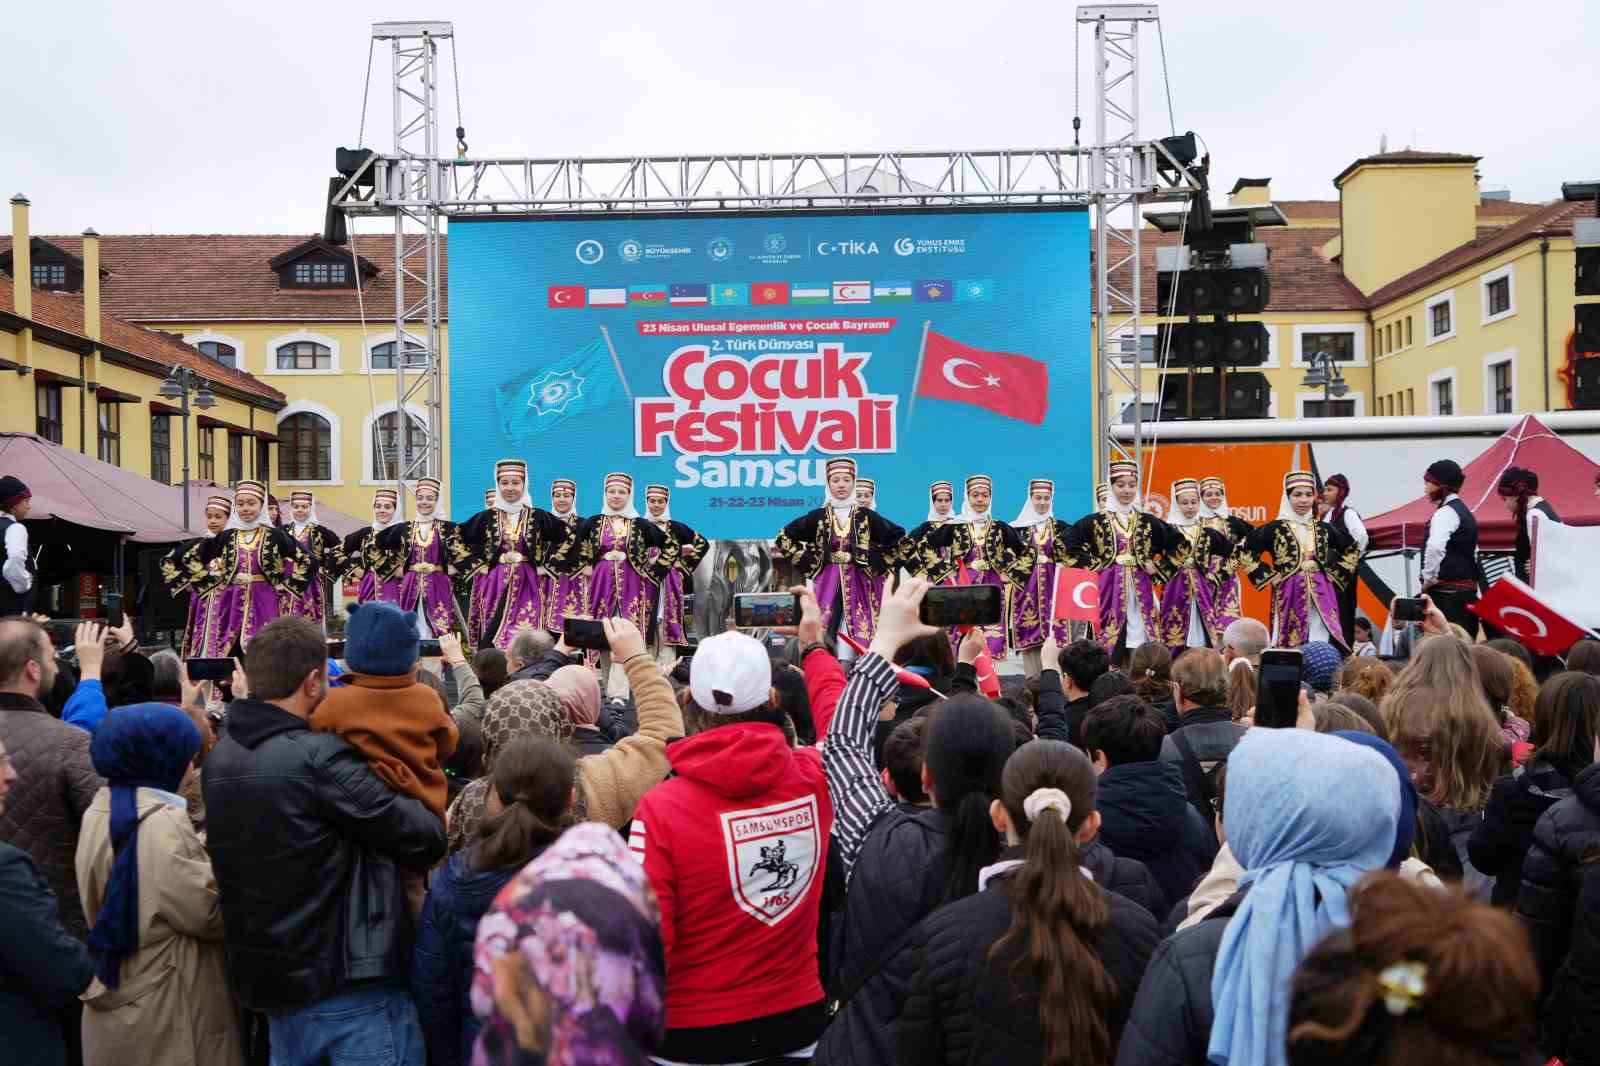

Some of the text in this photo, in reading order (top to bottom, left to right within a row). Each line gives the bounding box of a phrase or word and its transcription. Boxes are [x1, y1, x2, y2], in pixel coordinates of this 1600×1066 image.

[838, 240, 880, 255] TİKA
[642, 320, 890, 334] 23 Nisan Ulusal Egemenlik ve Çocuk Bayramı
[712, 339, 814, 351] 2. Türk Dünyası
[666, 345, 871, 409] Çocuk
[637, 396, 897, 455] Festivali
[674, 456, 828, 488] Samsu
[709, 497, 766, 508] 21-22-23
[767, 496, 805, 507] Nisan
[735, 811, 811, 837] SAMSUNSPOR
